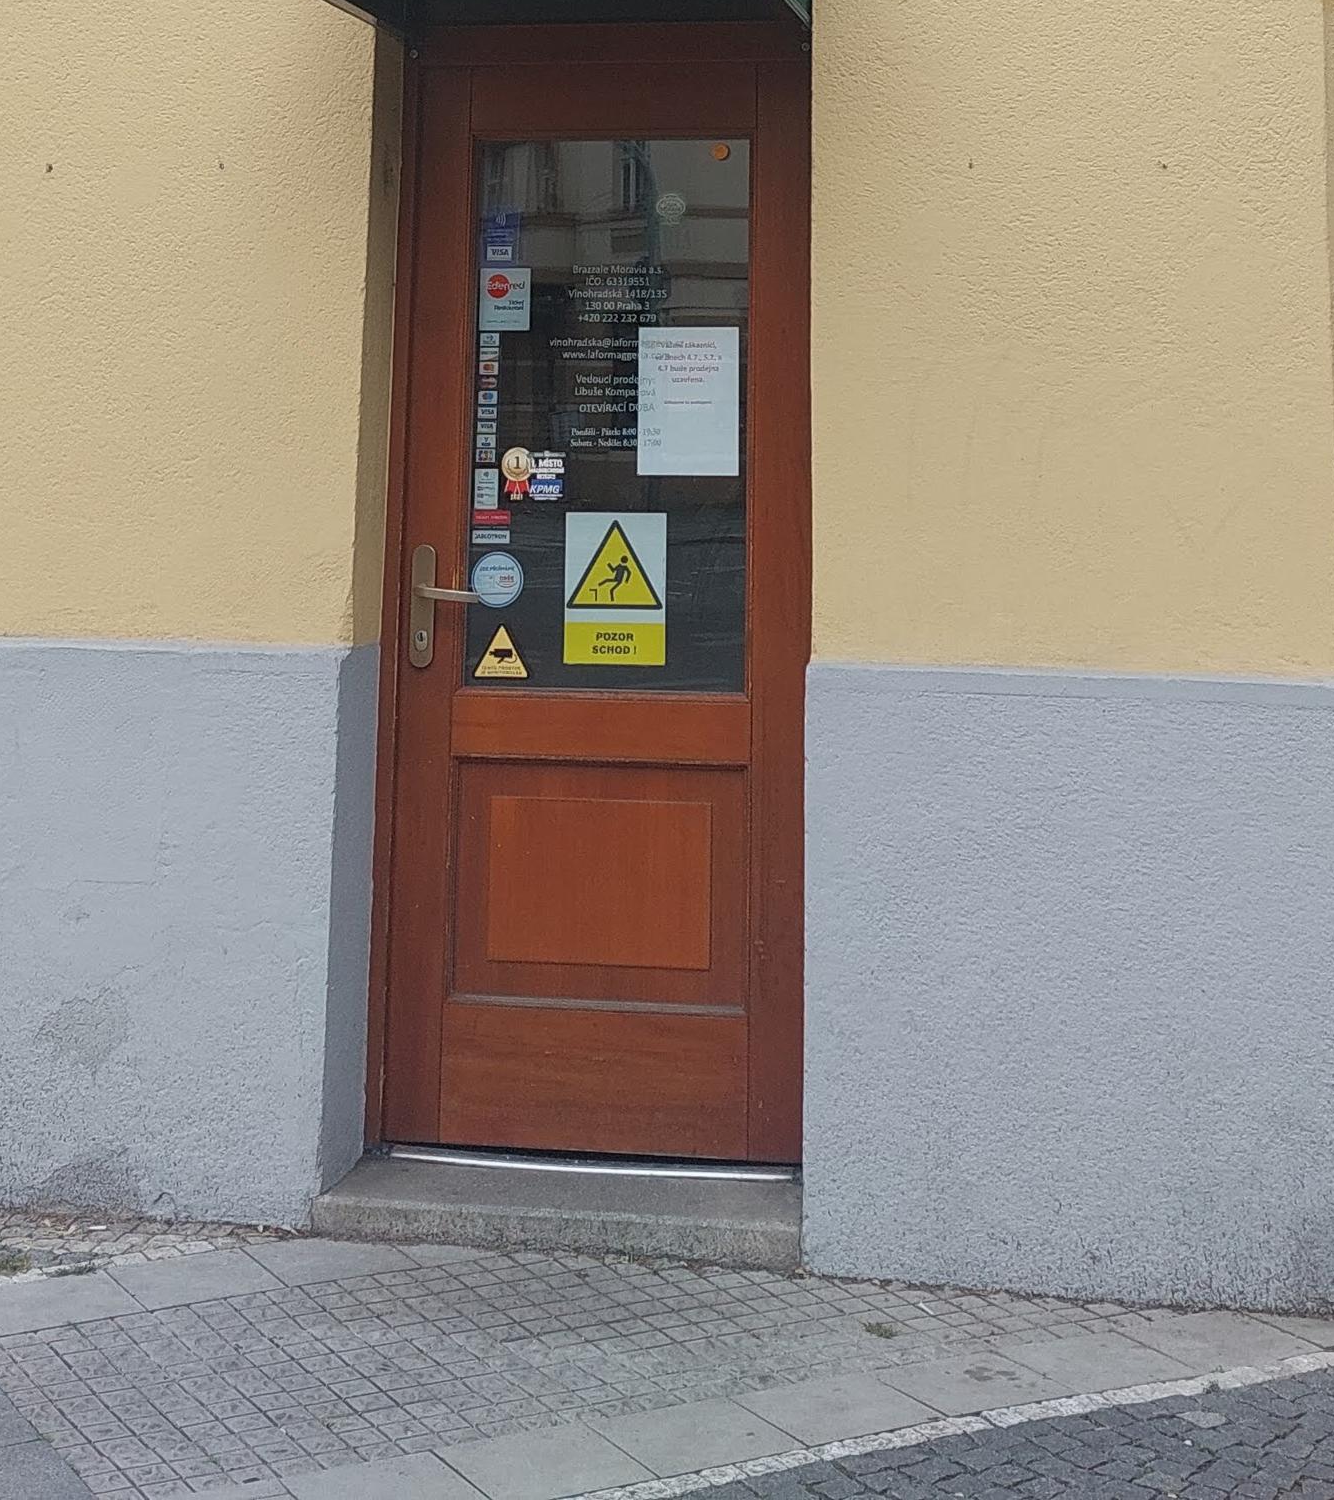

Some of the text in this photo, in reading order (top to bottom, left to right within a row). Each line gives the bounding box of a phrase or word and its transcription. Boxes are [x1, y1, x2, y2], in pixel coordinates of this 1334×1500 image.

[572, 265, 664, 275] Brazzale Moravia a.s.
[487, 281, 525, 290] Edenred
[568, 288, 622, 299] Vinohradská
[586, 301, 650, 311] 130 00 Praha 3
[575, 373, 611, 384] Vedoucí
[579, 401, 627, 413] OTEVÍRACÍ
[628, 402, 655, 412] DOBA
[529, 484, 560, 494] KPMG
[595, 631, 635, 642] POZOR
[591, 645, 631, 655] SCHOD
